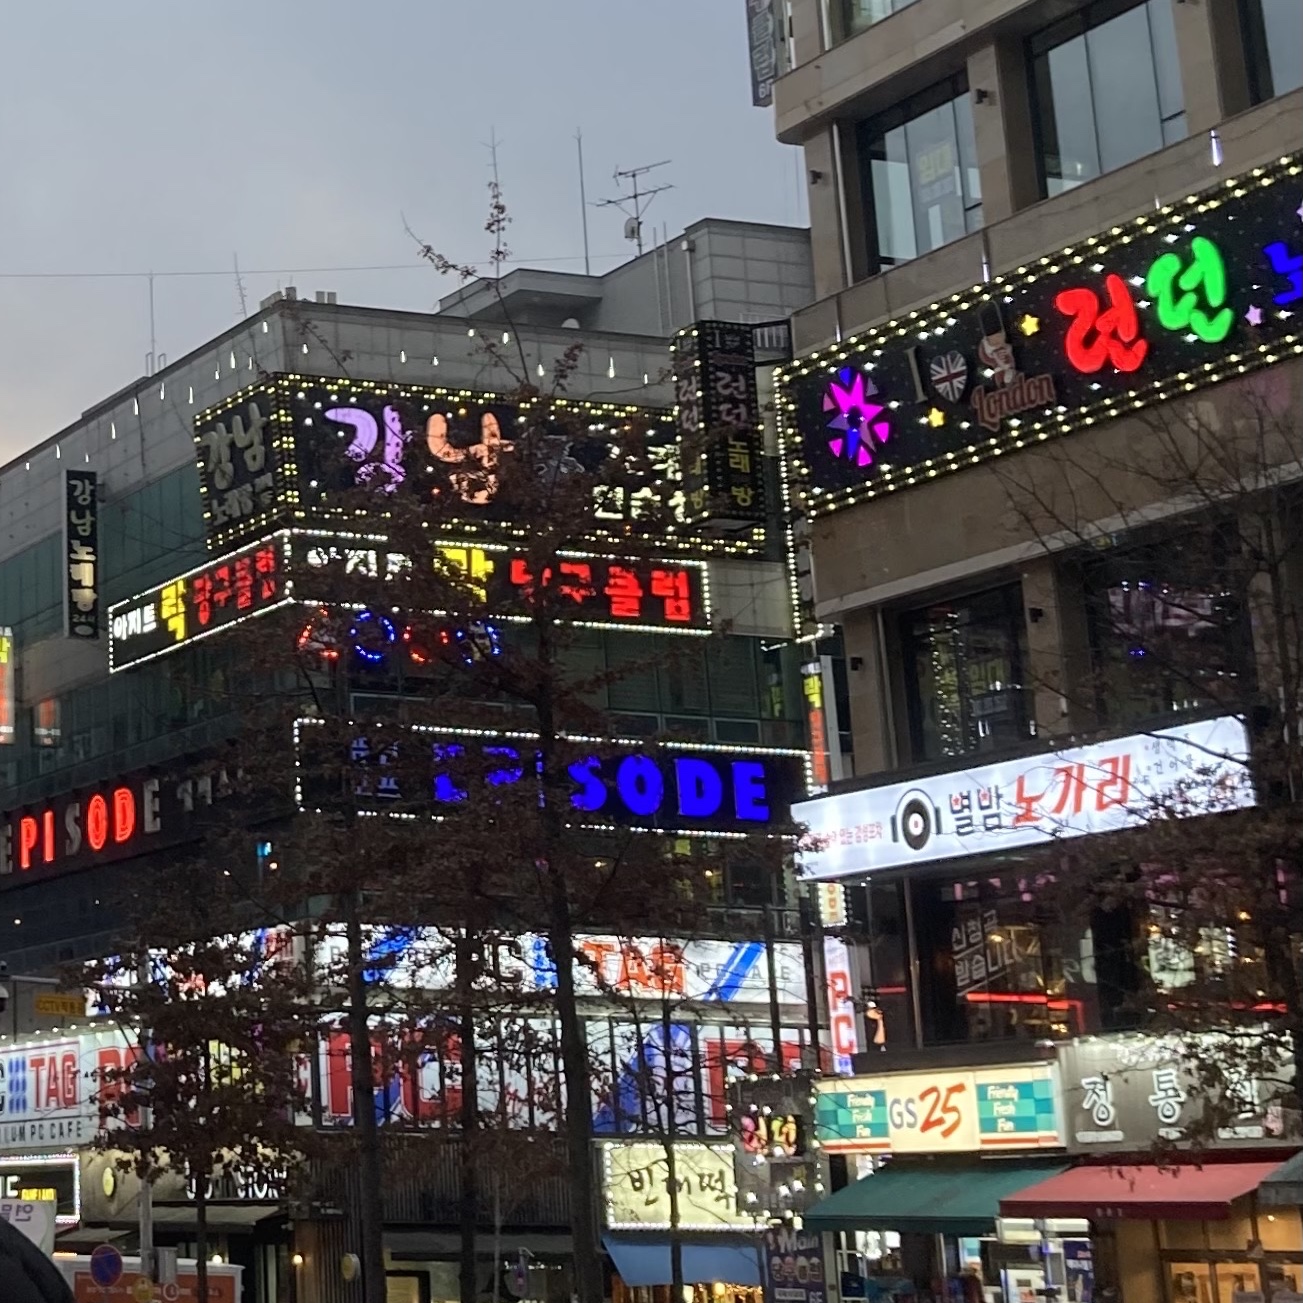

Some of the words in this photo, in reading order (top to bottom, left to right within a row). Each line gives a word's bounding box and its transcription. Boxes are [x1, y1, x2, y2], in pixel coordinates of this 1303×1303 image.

[1056, 236, 1234, 373] 런던
[970, 373, 1057, 431] London
[198, 402, 269, 490] 강남
[68, 479, 96, 536] 강남
[0, 778, 161, 875] EPISODE
[949, 786, 1002, 837] 별밤
[1012, 753, 1132, 829] 노가리
[829, 971, 854, 1056] PC
[30, 1052, 77, 1111] TAG
[889, 1083, 966, 1139] GS25
[30, 1125, 45, 1141] PC
[50, 1120, 83, 1140] CAFE
